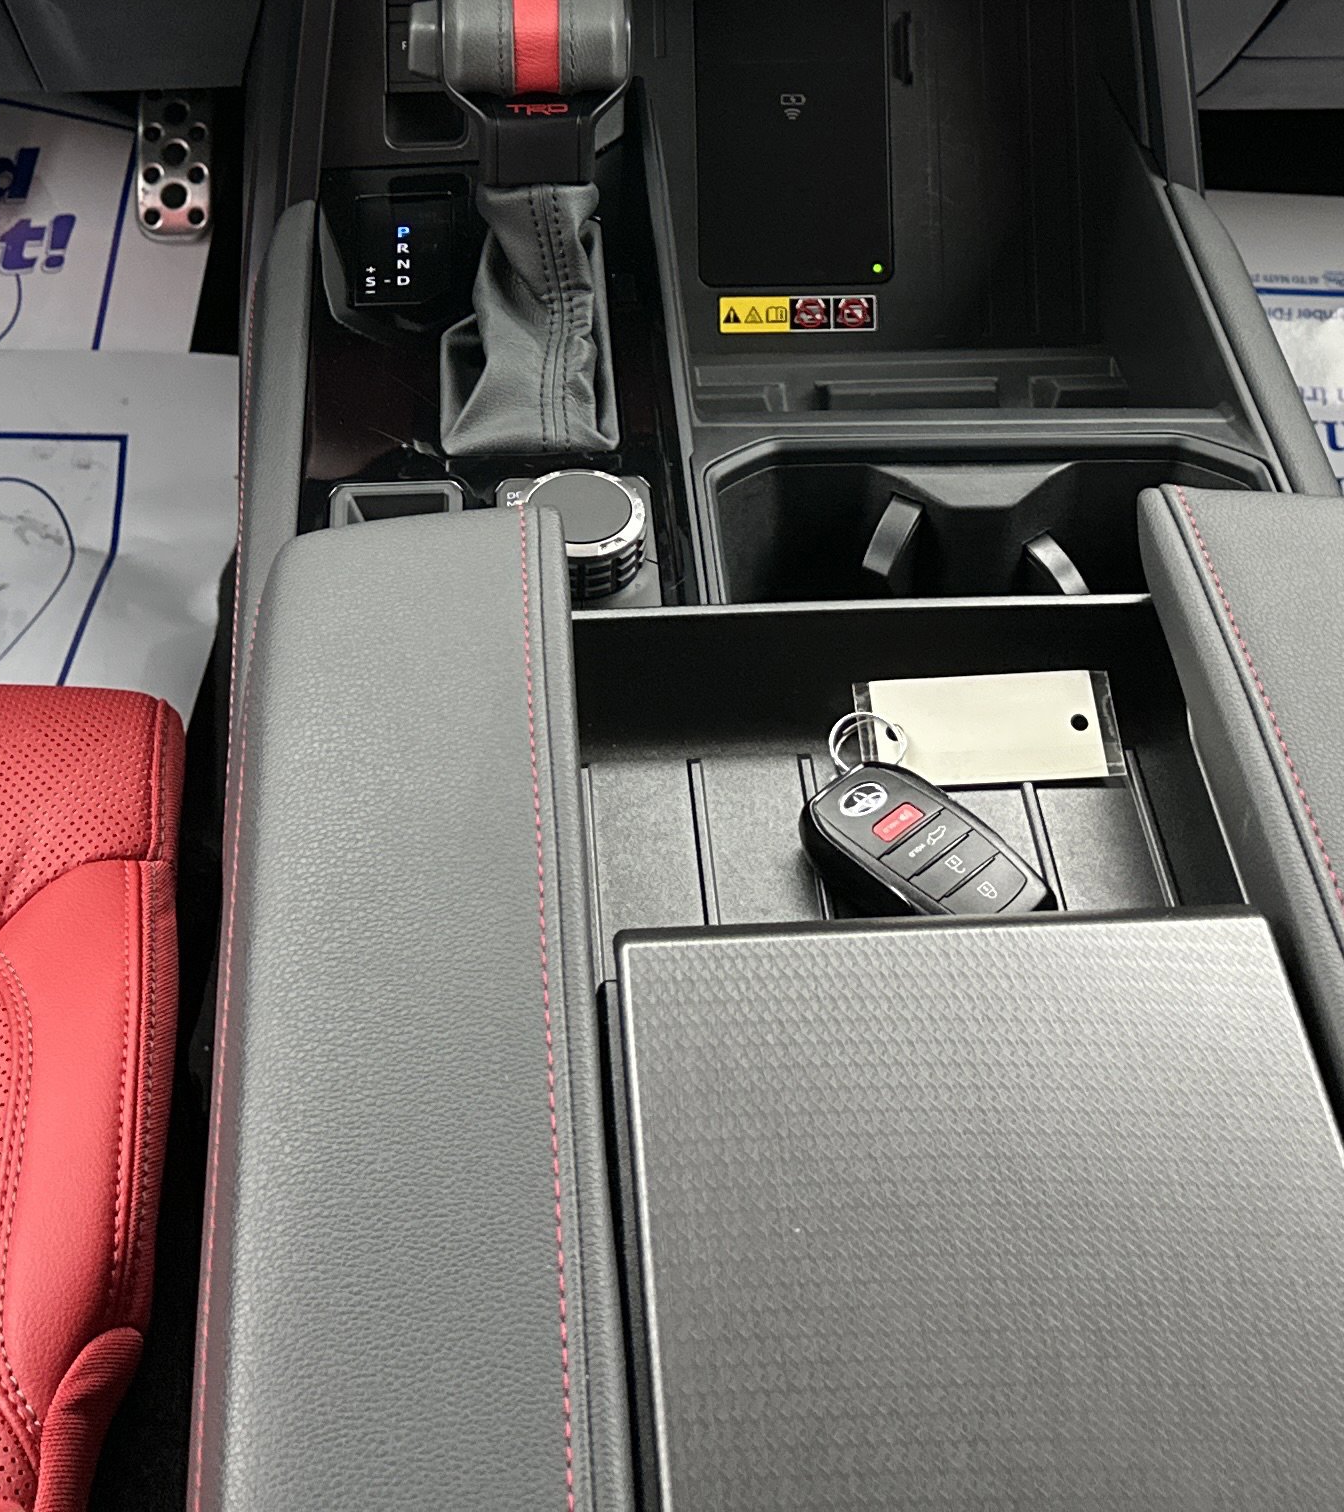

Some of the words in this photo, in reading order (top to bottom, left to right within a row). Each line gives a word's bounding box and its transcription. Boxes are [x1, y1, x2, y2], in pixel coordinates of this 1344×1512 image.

[506, 103, 569, 116] TRD
[397, 226, 410, 238] P
[396, 242, 410, 254] R
[396, 258, 410, 270] N
[365, 276, 376, 287] S
[396, 275, 410, 286] D
